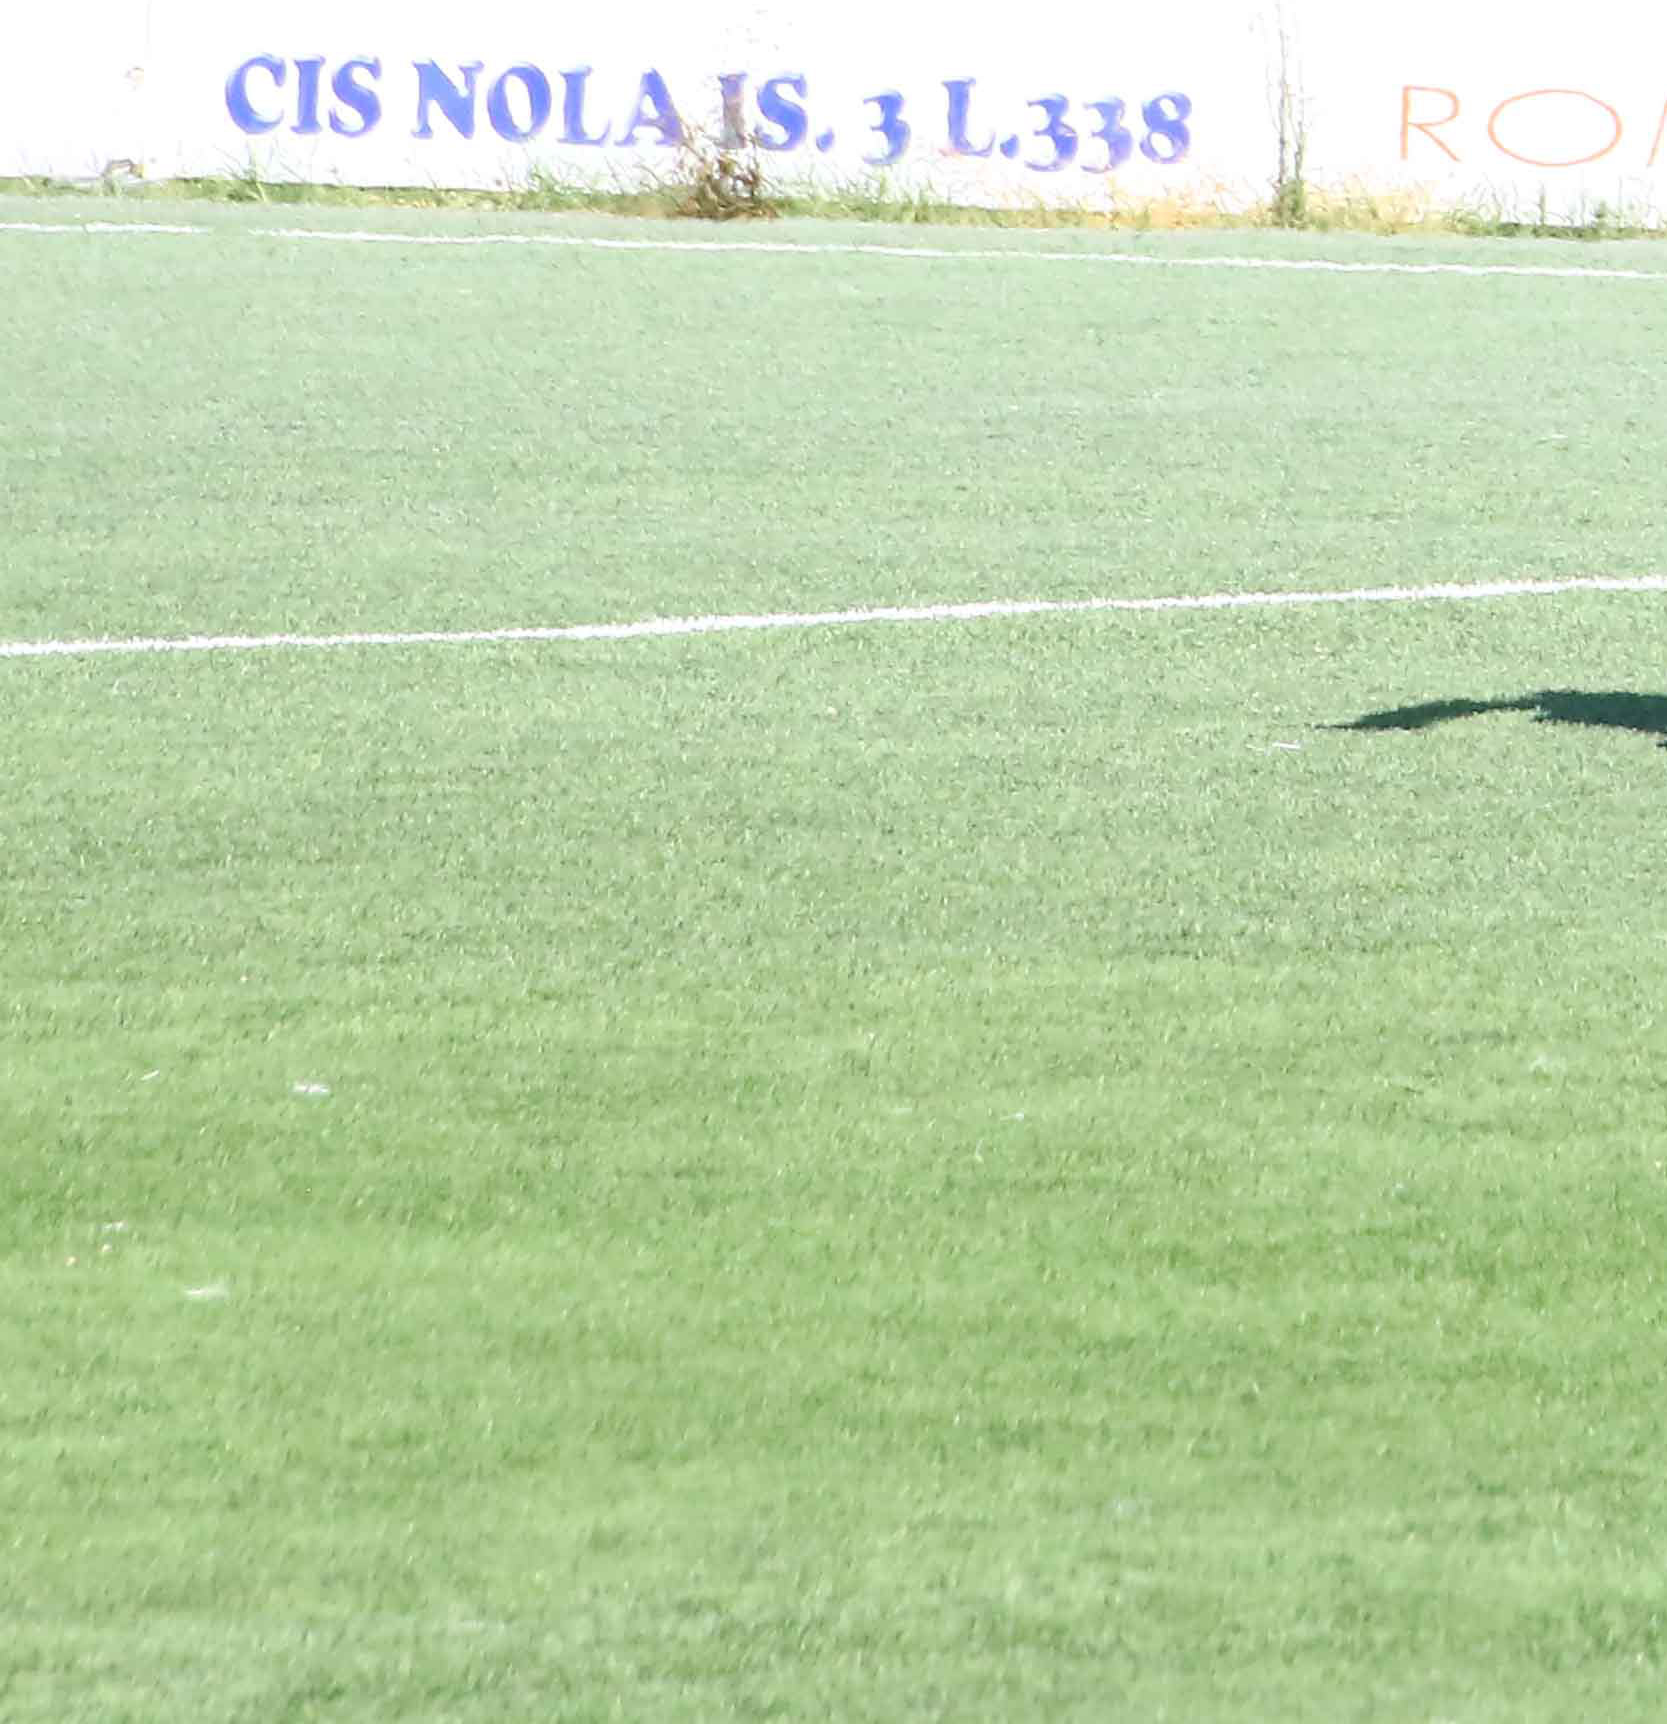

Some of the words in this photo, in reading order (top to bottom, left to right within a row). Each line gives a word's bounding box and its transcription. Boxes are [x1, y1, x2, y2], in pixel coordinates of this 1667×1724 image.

[224, 52, 383, 139] CIS
[410, 58, 686, 149] NOLA
[862, 89, 912, 165] 3
